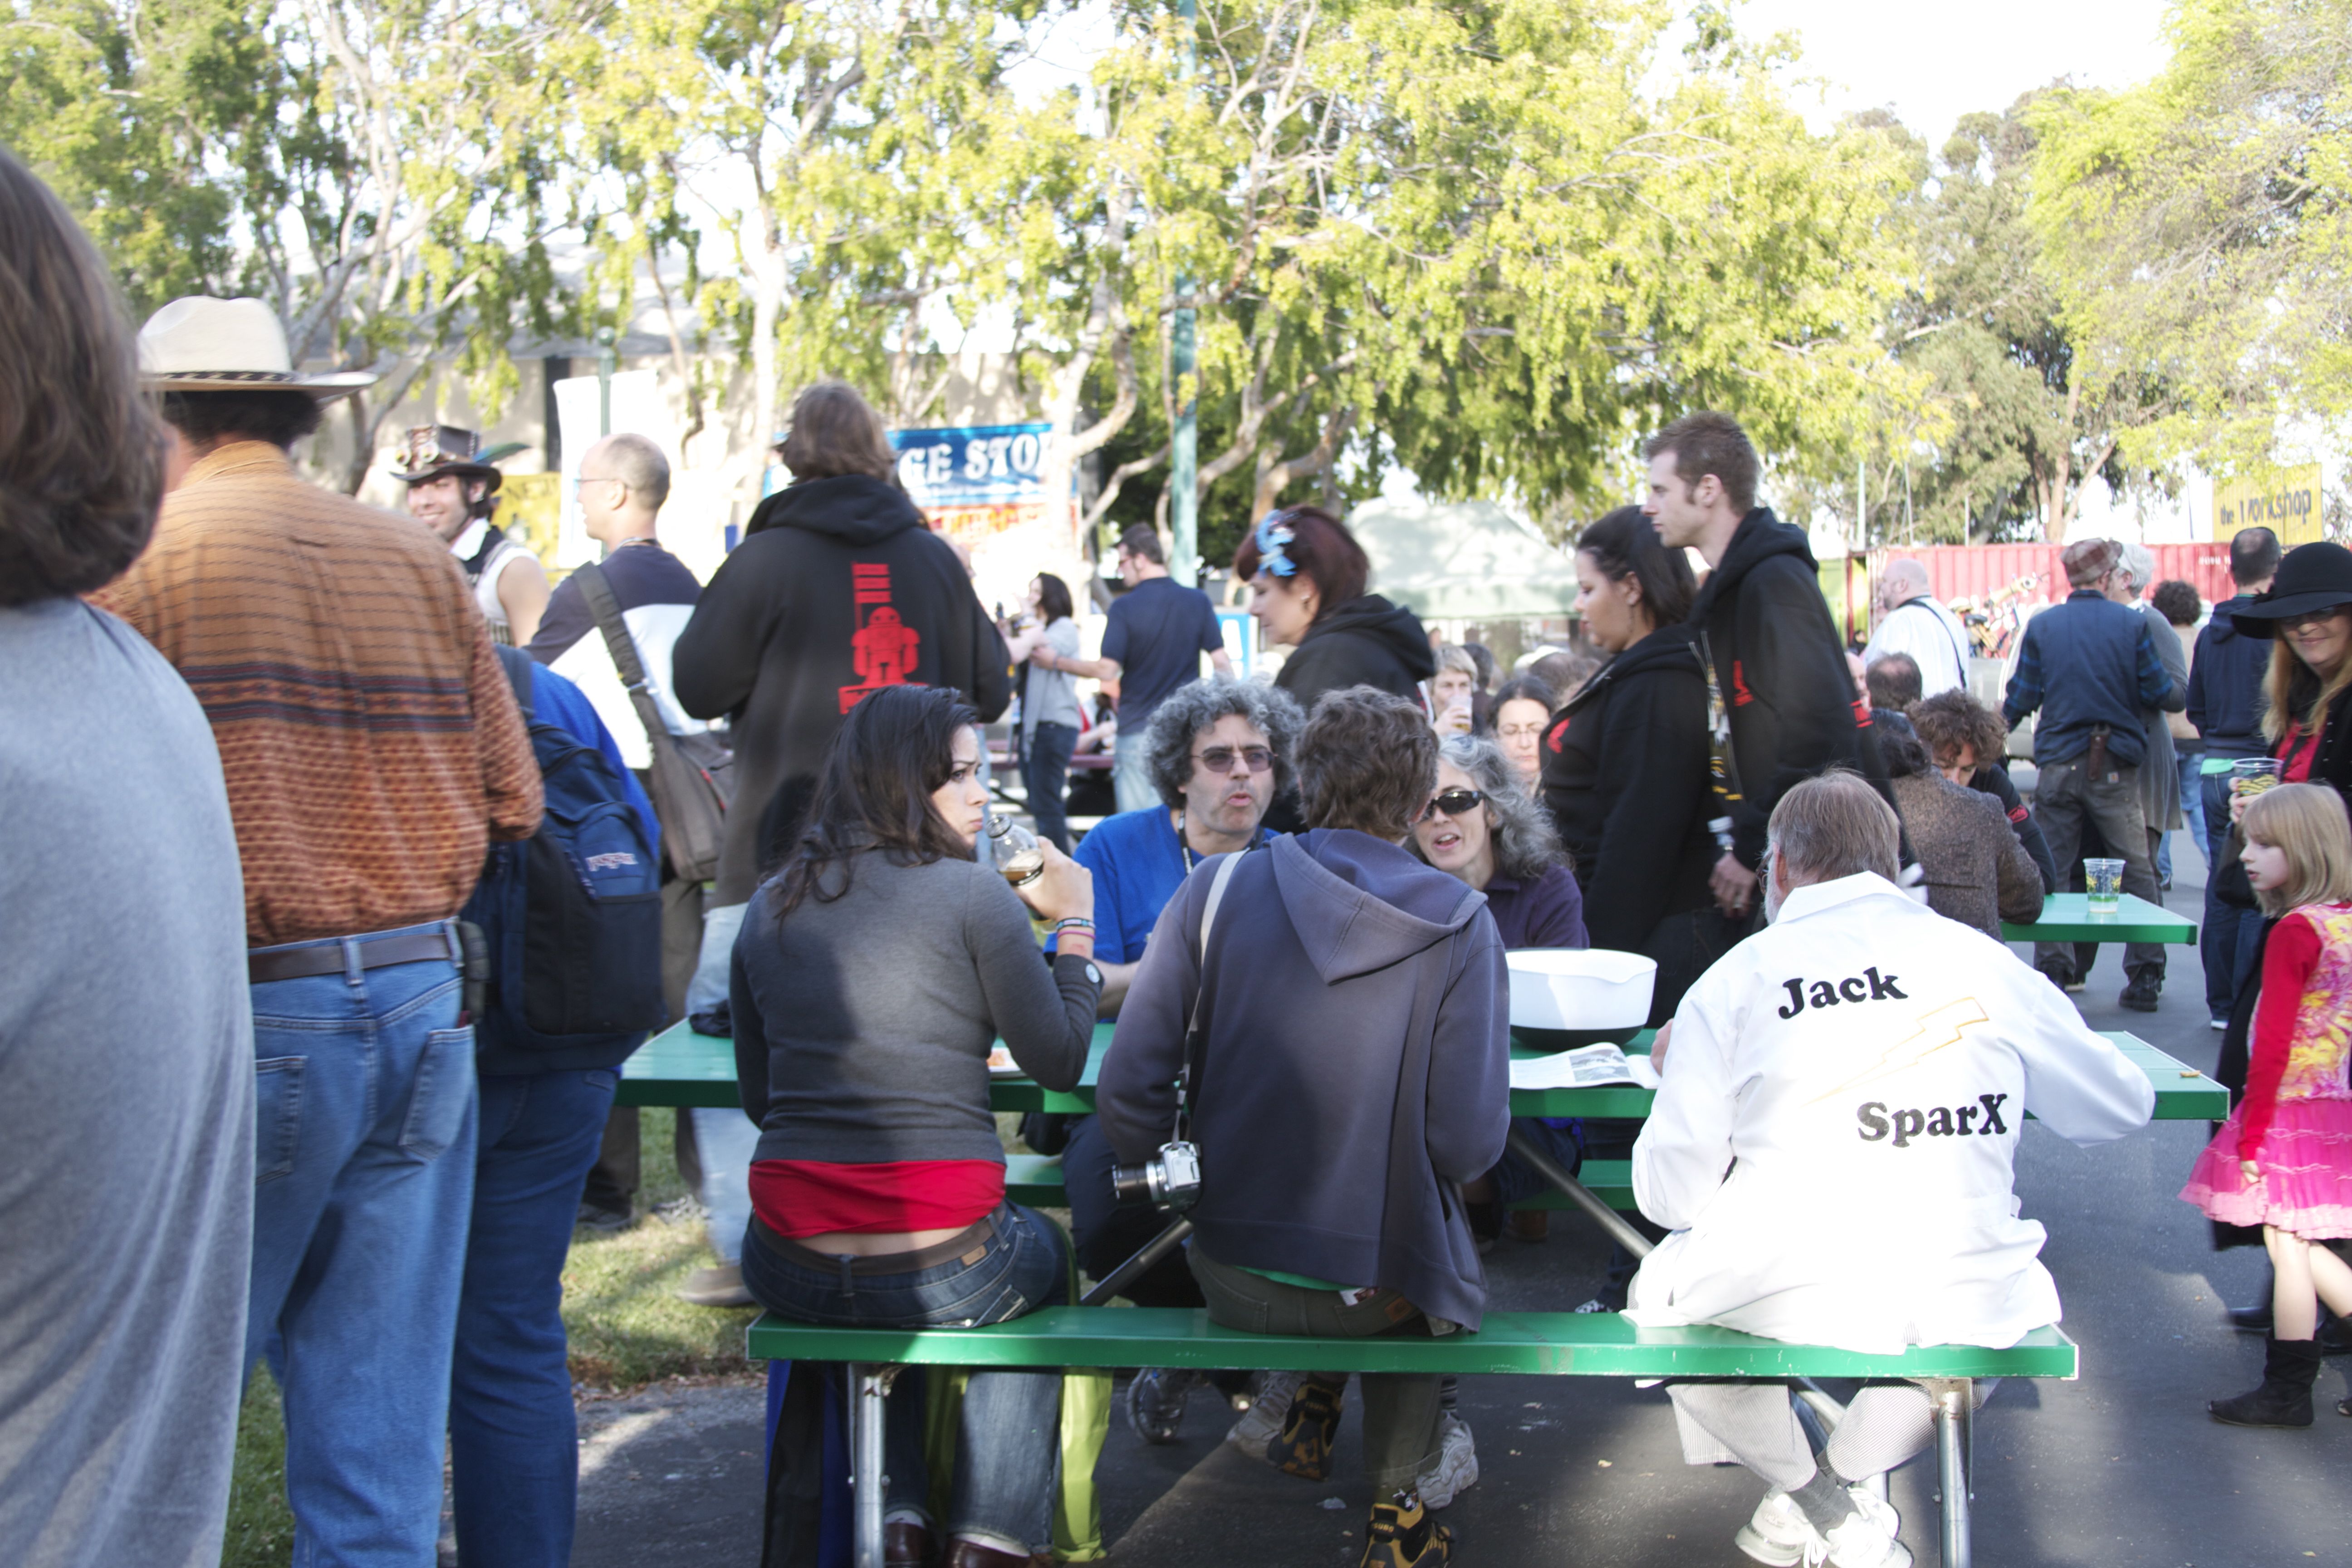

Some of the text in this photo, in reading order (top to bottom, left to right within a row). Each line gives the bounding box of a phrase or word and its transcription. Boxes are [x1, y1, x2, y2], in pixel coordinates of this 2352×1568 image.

[898, 443, 953, 489] GE
[1778, 966, 1909, 1019] Jack
[1857, 1093, 2008, 1148] SparX
